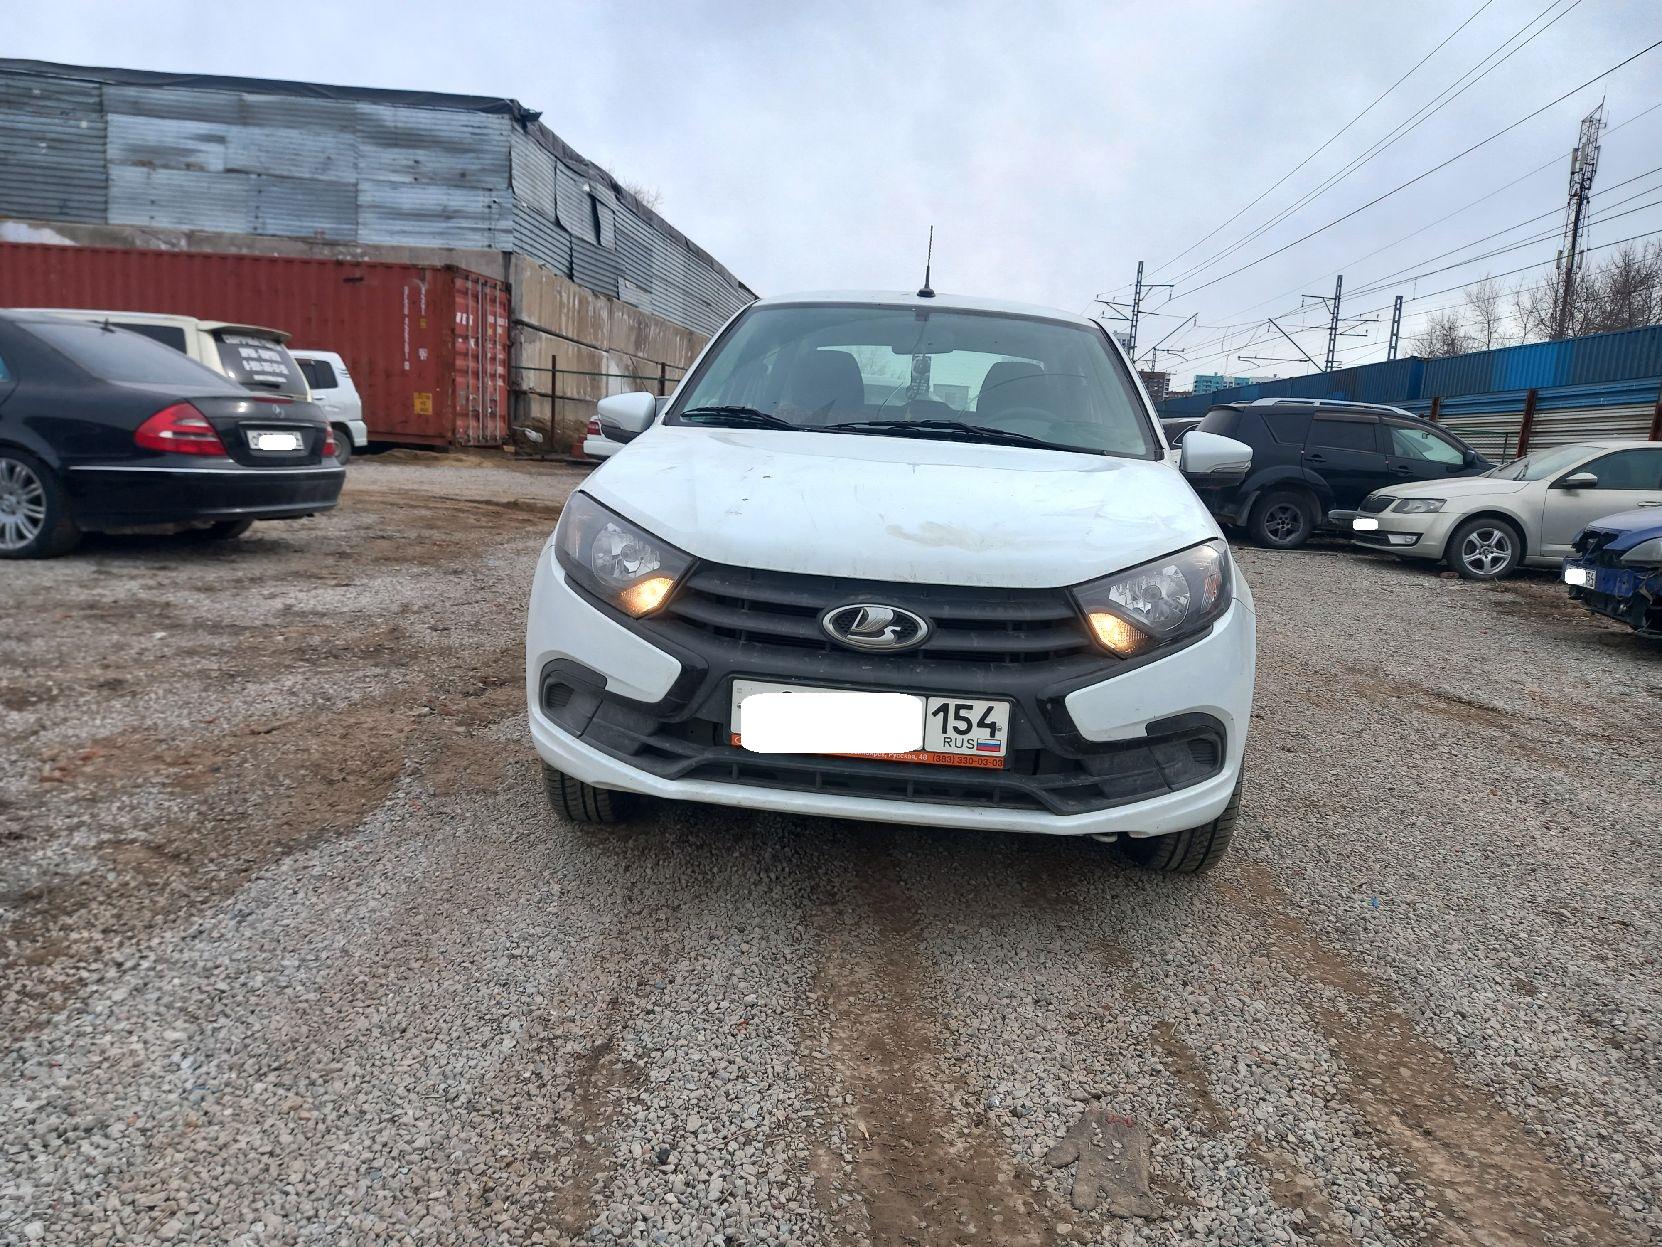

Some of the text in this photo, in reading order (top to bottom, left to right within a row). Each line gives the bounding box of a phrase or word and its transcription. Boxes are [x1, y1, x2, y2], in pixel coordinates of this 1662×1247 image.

[931, 702, 997, 738] 154
[943, 736, 975, 750] RUS
[932, 753, 955, 764] (383)
[956, 756, 1003, 767] 330-03-03
